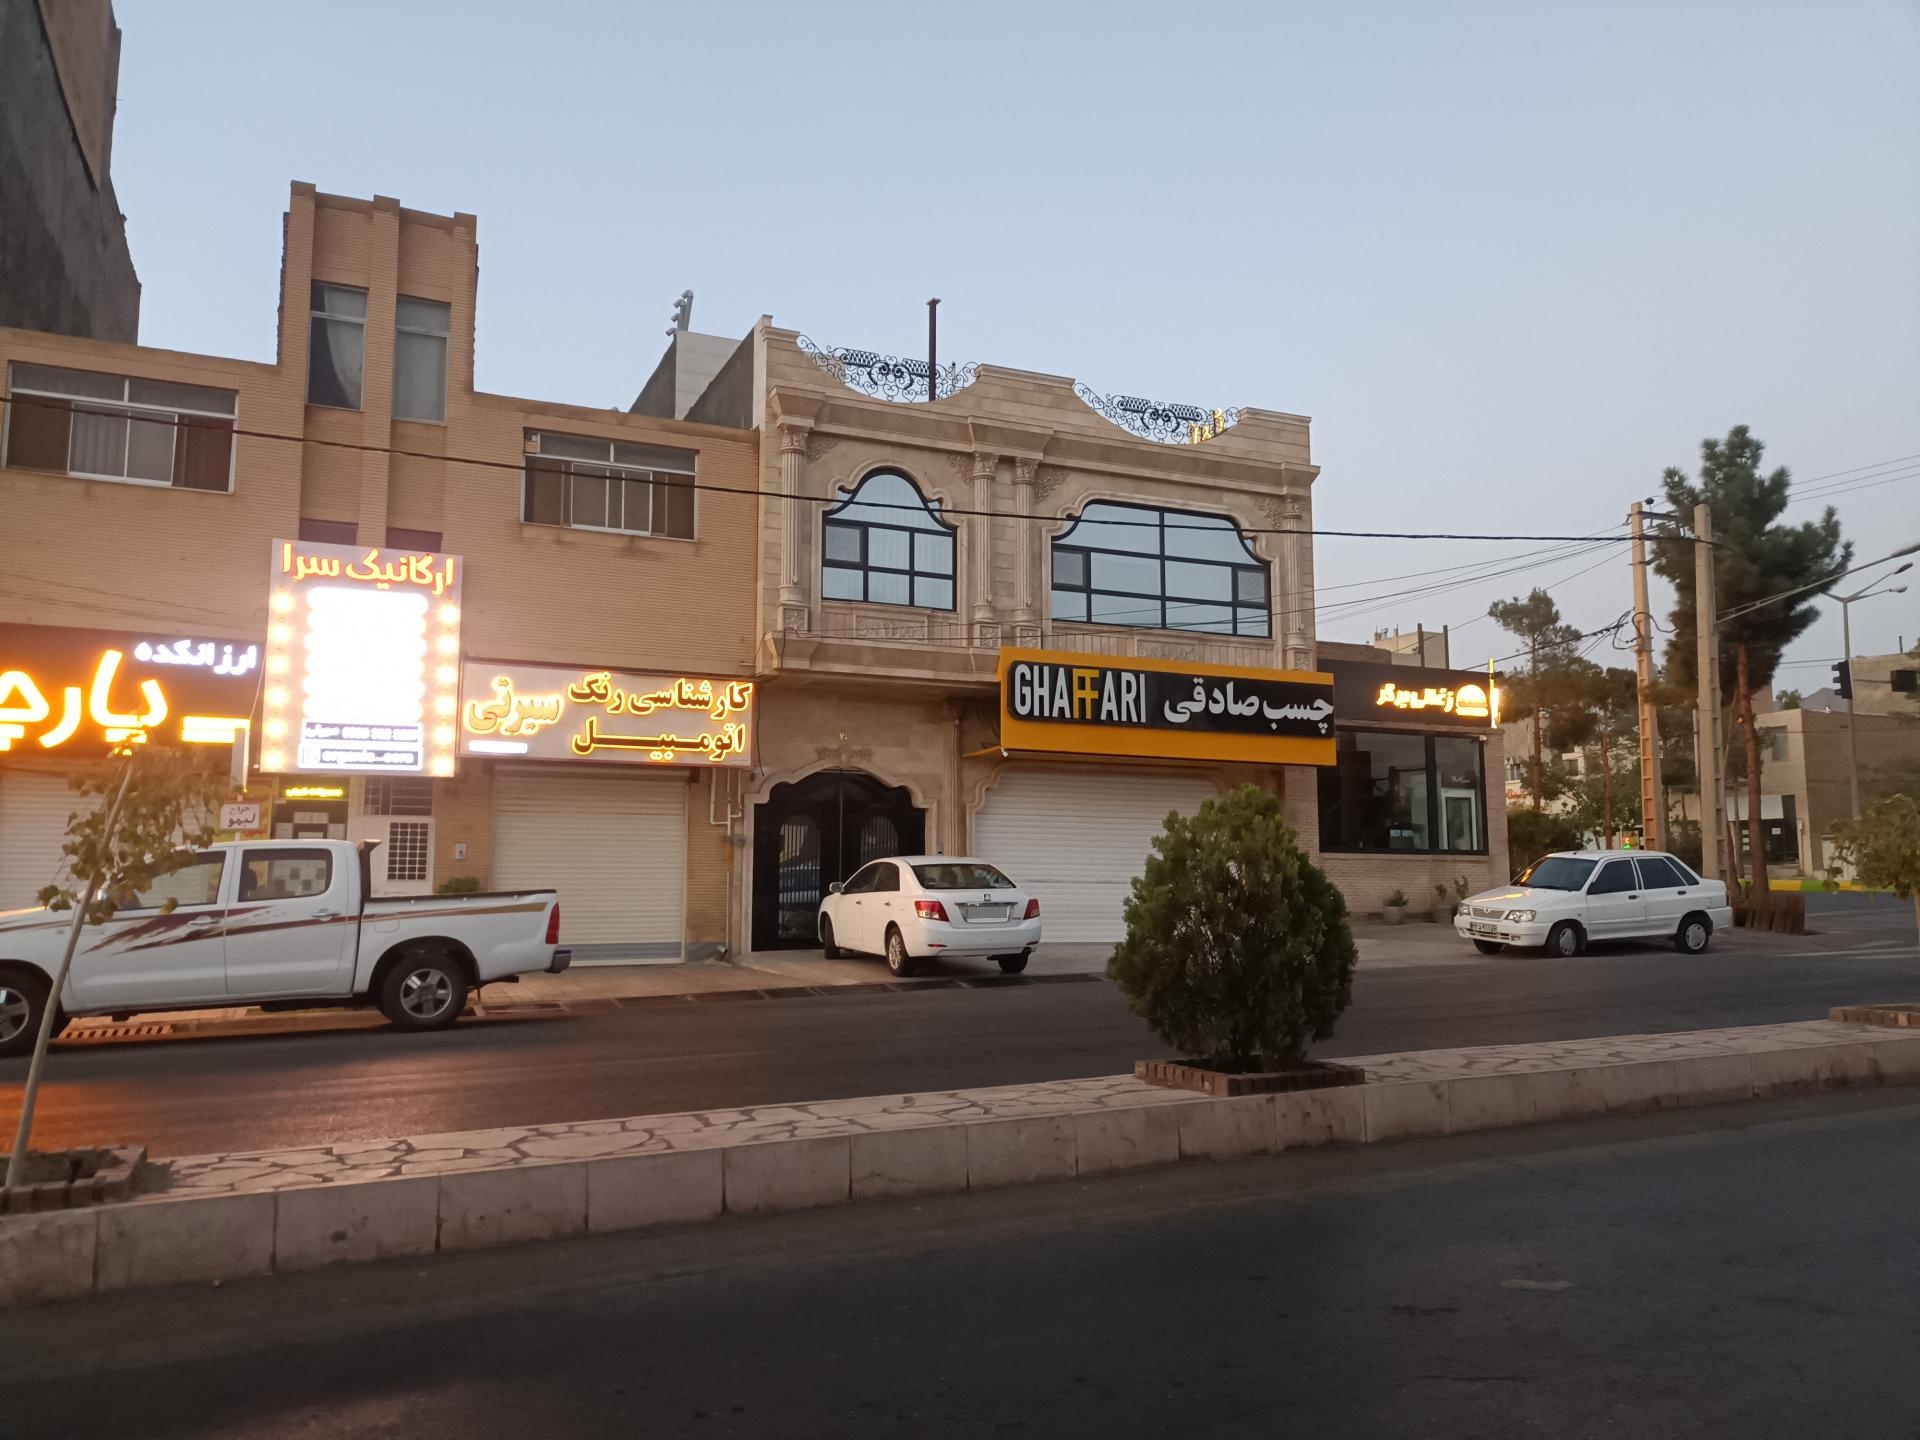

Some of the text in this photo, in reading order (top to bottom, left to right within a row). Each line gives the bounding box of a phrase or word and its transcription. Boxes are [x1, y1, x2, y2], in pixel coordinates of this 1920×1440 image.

[282, 542, 454, 596] ارگانیک سرا
[134, 639, 257, 676] ارزانکده
[464, 674, 564, 736] سیرتی
[568, 671, 754, 719] کارشناسی رنگ
[1014, 663, 1147, 723] GHAFFARI
[1164, 677, 1334, 735] چسب صادقی
[572, 715, 746, 761] اتومبیل
[227, 812, 256, 828] لیمو
